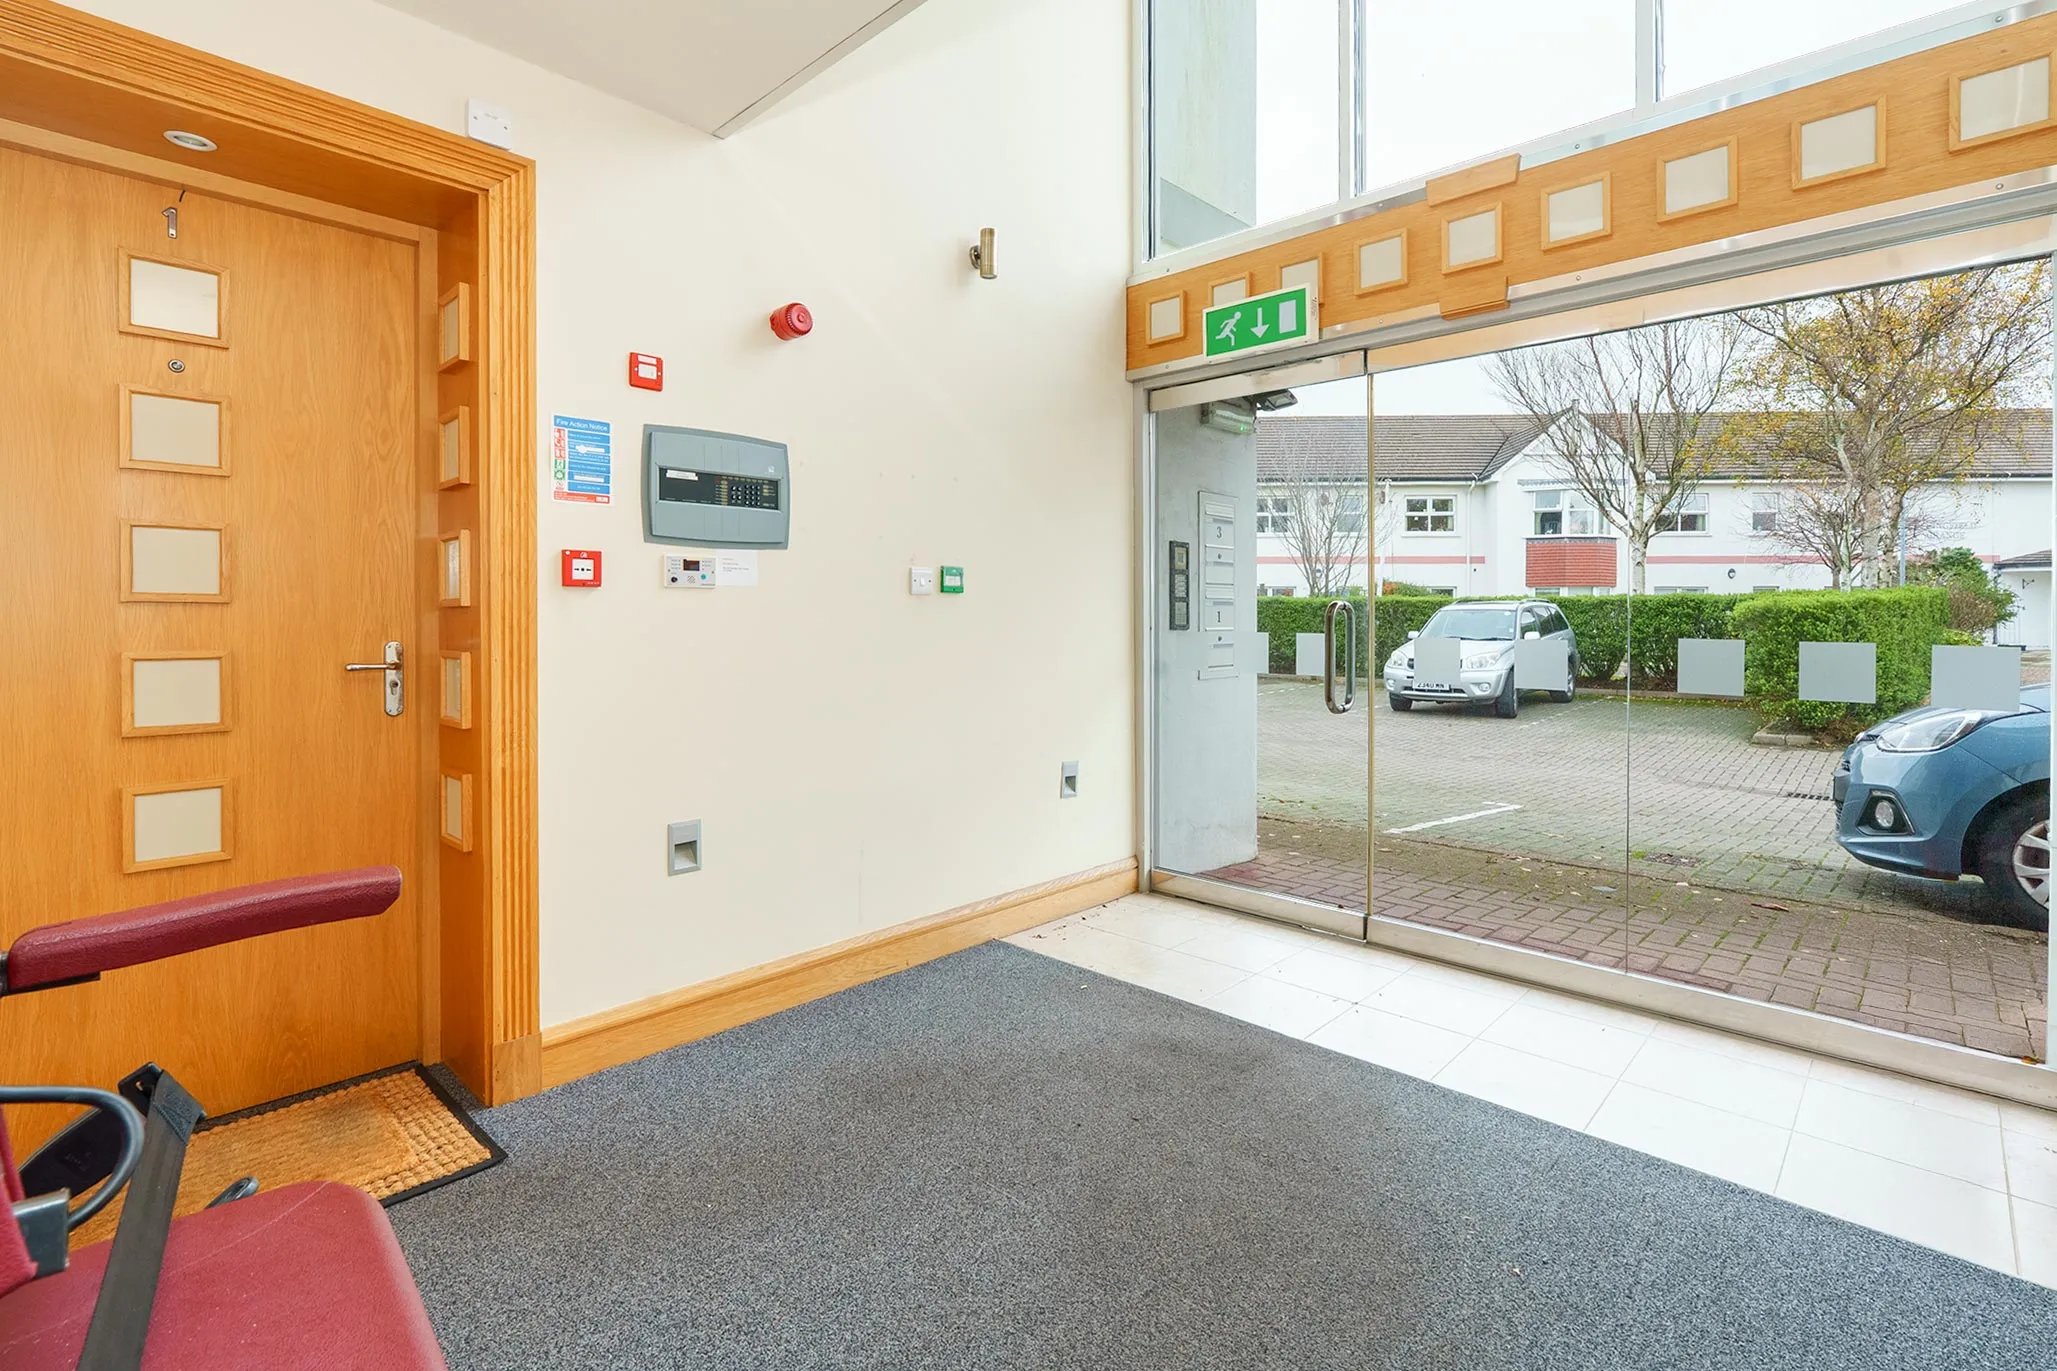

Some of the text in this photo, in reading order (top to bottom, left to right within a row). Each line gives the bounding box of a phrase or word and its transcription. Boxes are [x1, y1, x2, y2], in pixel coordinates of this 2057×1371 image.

[161, 206, 177, 239] 1
[556, 418, 608, 432] Fire Action Notice
[1216, 526, 1222, 539] 3
[1217, 610, 1221, 623] 1
